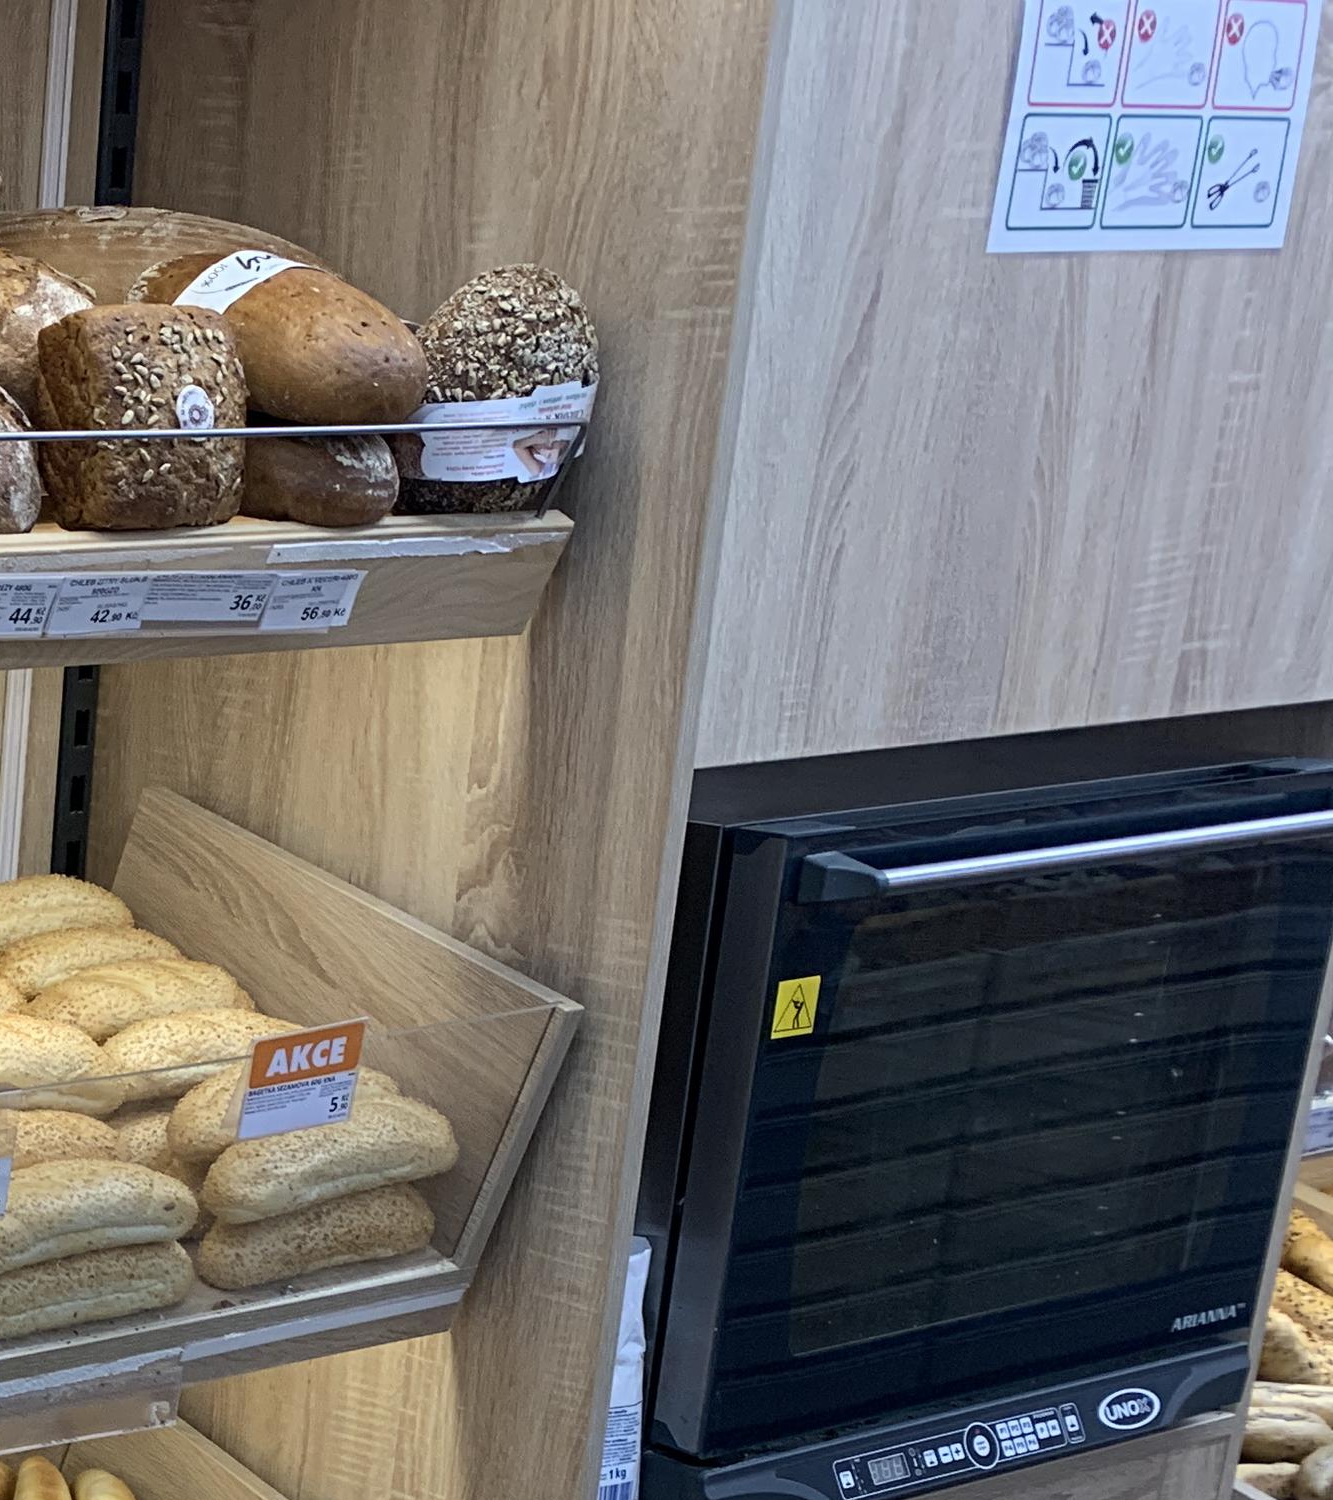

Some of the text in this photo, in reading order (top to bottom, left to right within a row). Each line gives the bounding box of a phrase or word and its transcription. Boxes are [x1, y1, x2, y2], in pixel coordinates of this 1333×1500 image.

[265, 1036, 347, 1078] AKCE
[1171, 1305, 1237, 1332] ARIANNA
[1106, 1396, 1151, 1423] UNOX
